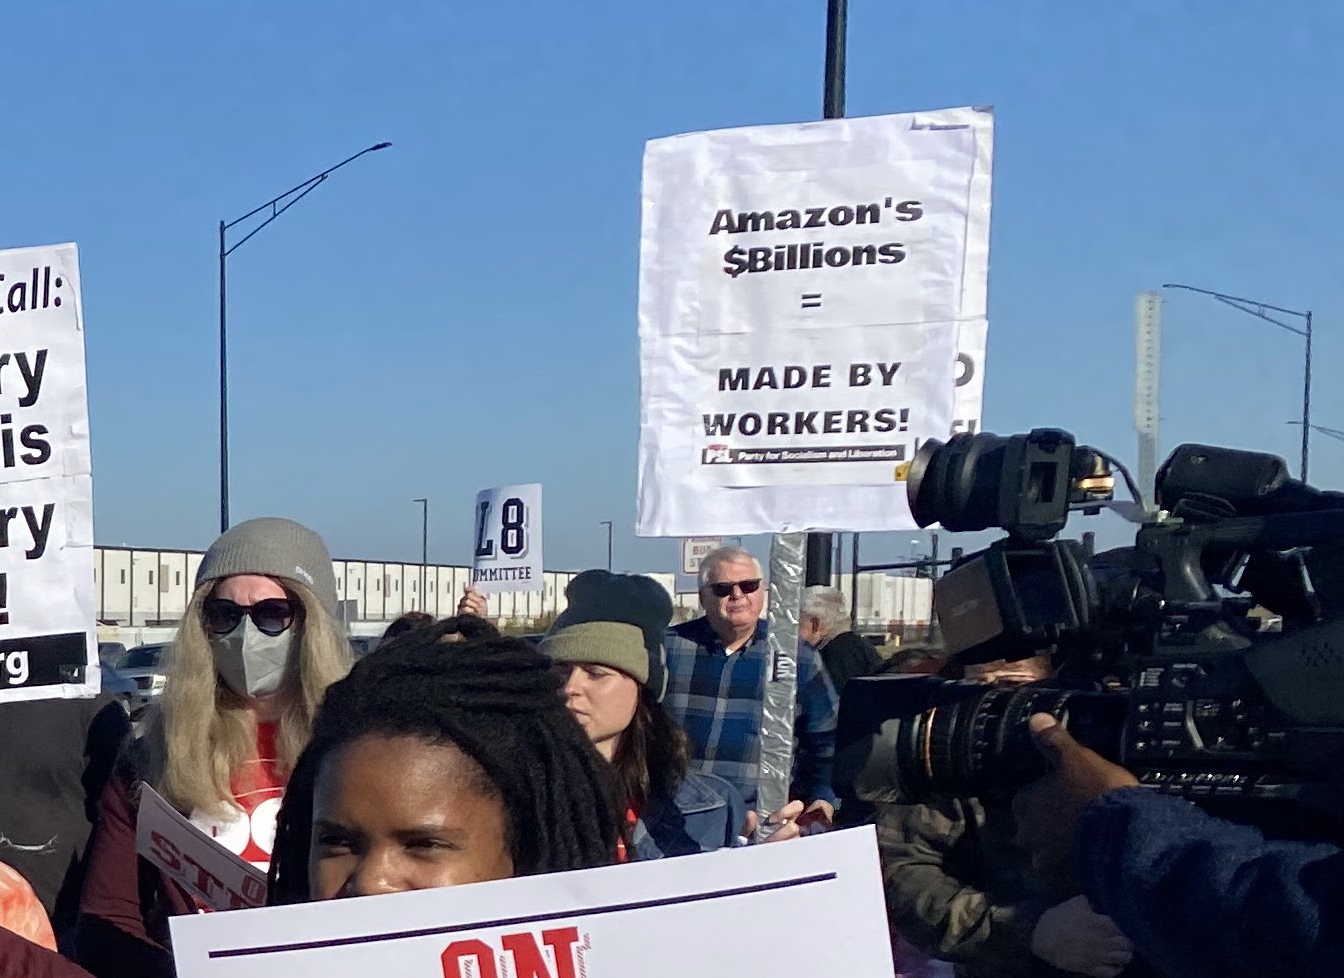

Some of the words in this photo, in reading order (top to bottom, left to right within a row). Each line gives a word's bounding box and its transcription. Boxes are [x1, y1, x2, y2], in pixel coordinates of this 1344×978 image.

[709, 197, 924, 235] Amazon's
[724, 241, 906, 278] $Billions
[718, 365, 832, 391] MADE
[849, 362, 902, 387] BY
[702, 408, 910, 436] WORKERS!
[0, 413, 52, 468] is
[765, 451, 779, 461] for
